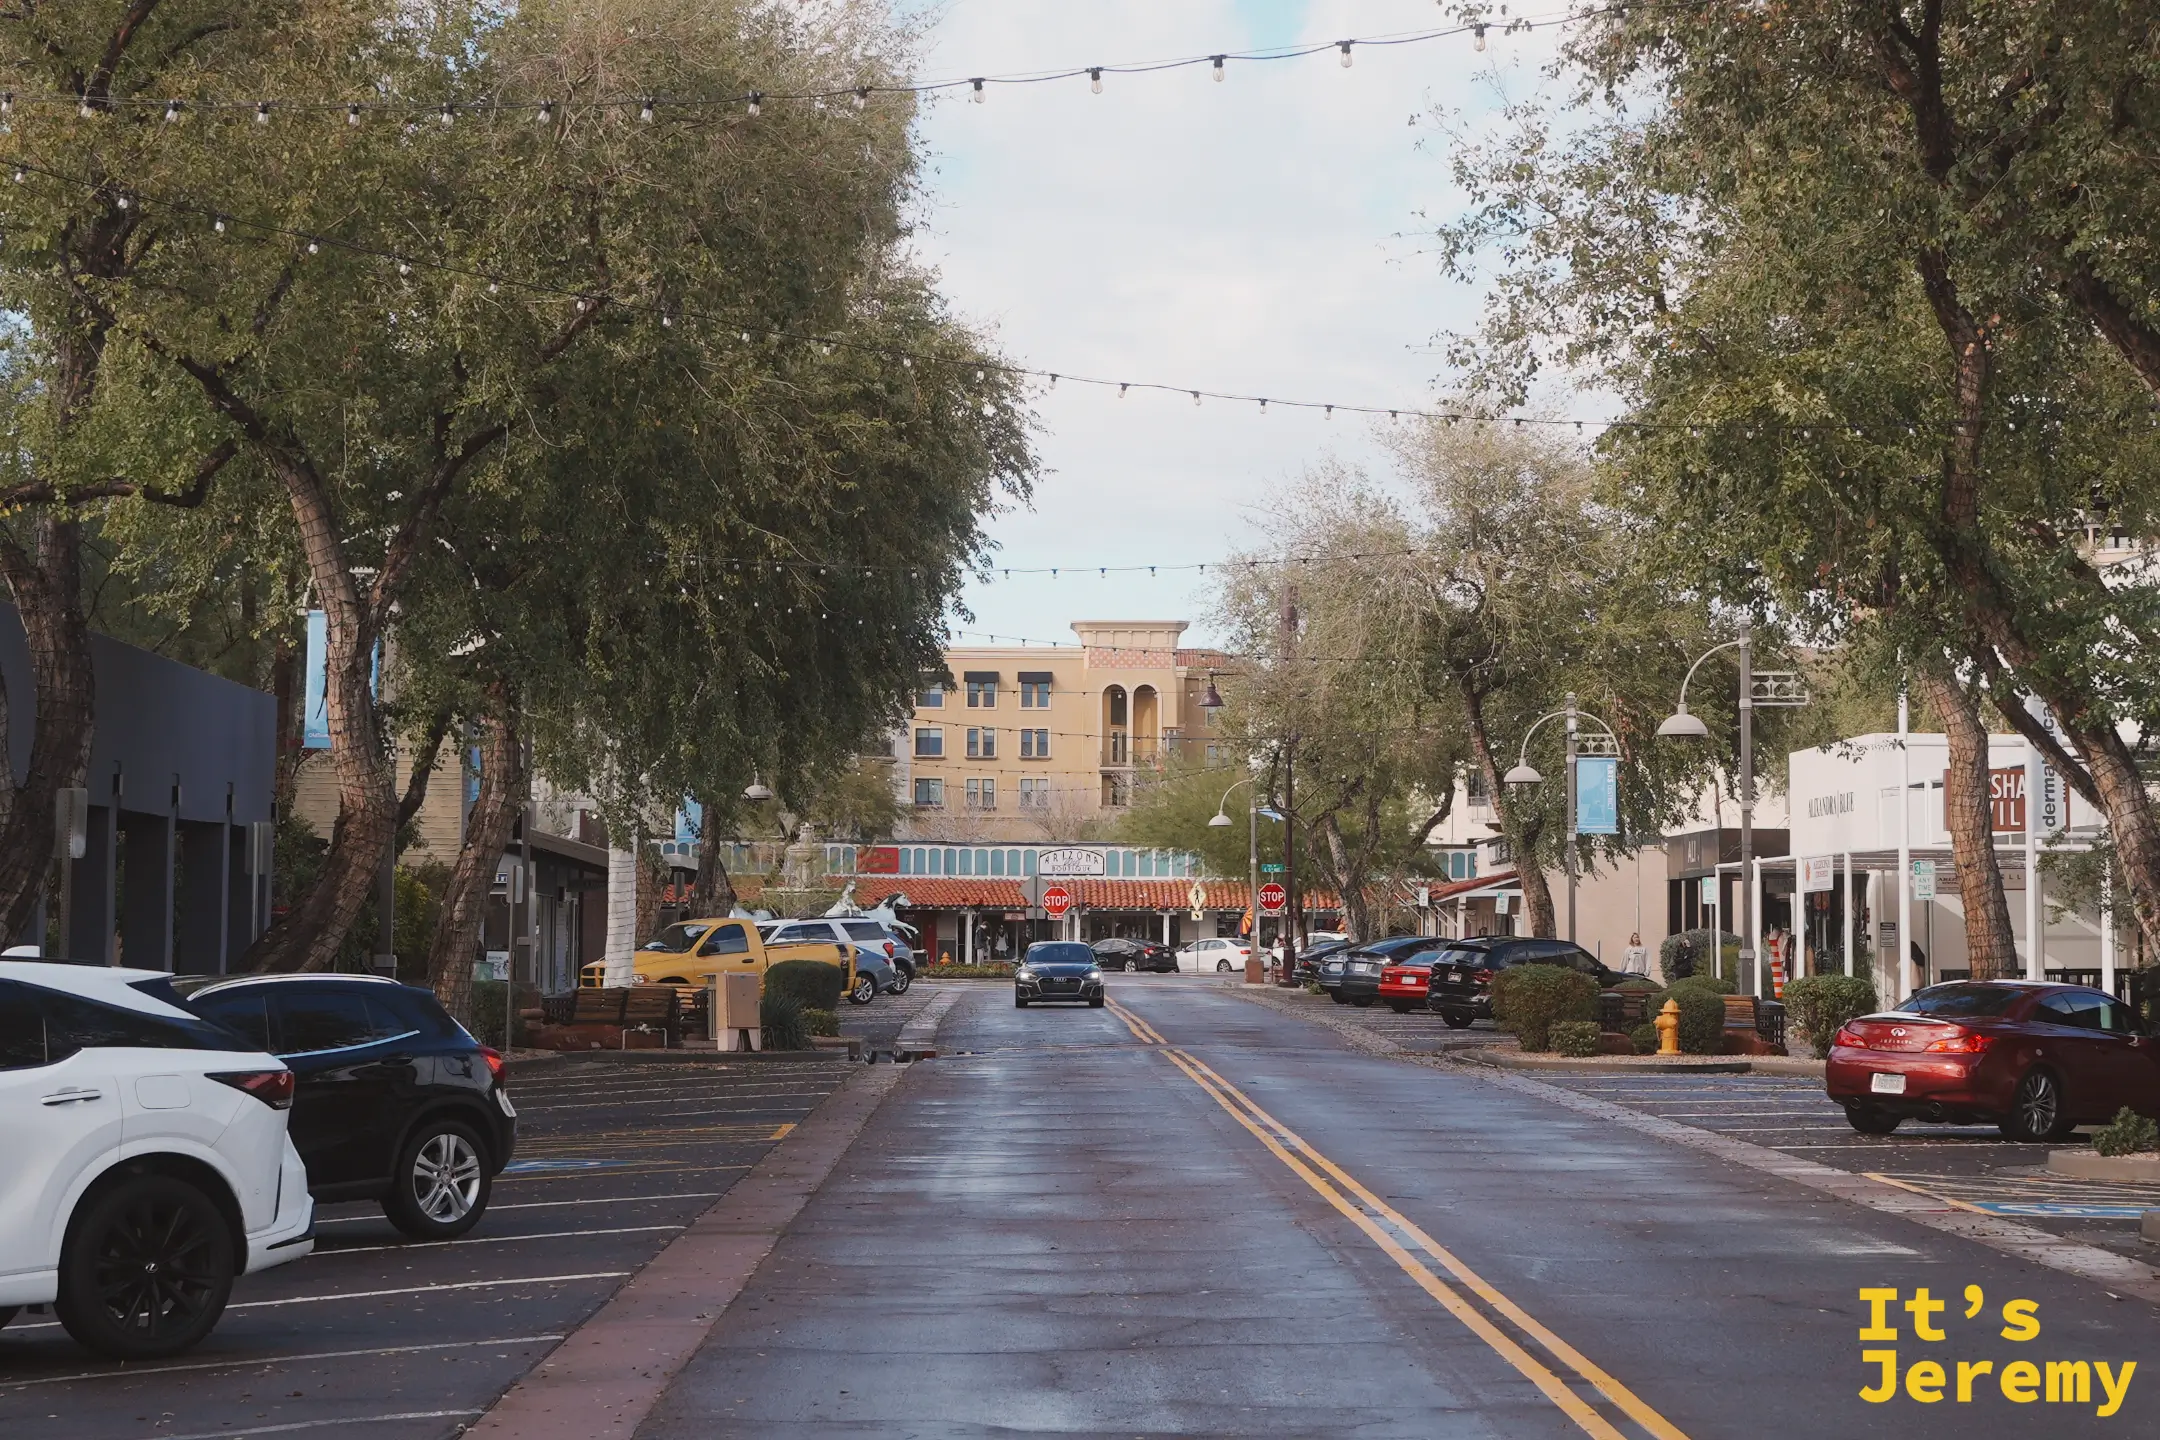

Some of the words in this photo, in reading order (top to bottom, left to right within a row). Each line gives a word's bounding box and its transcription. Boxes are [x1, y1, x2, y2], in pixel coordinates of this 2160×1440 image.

[2042, 707, 2055, 827] dermaca
[1045, 851, 1099, 864] ARIZONA
[1045, 896, 1068, 906] STOP
[1261, 892, 1284, 902] STOP
